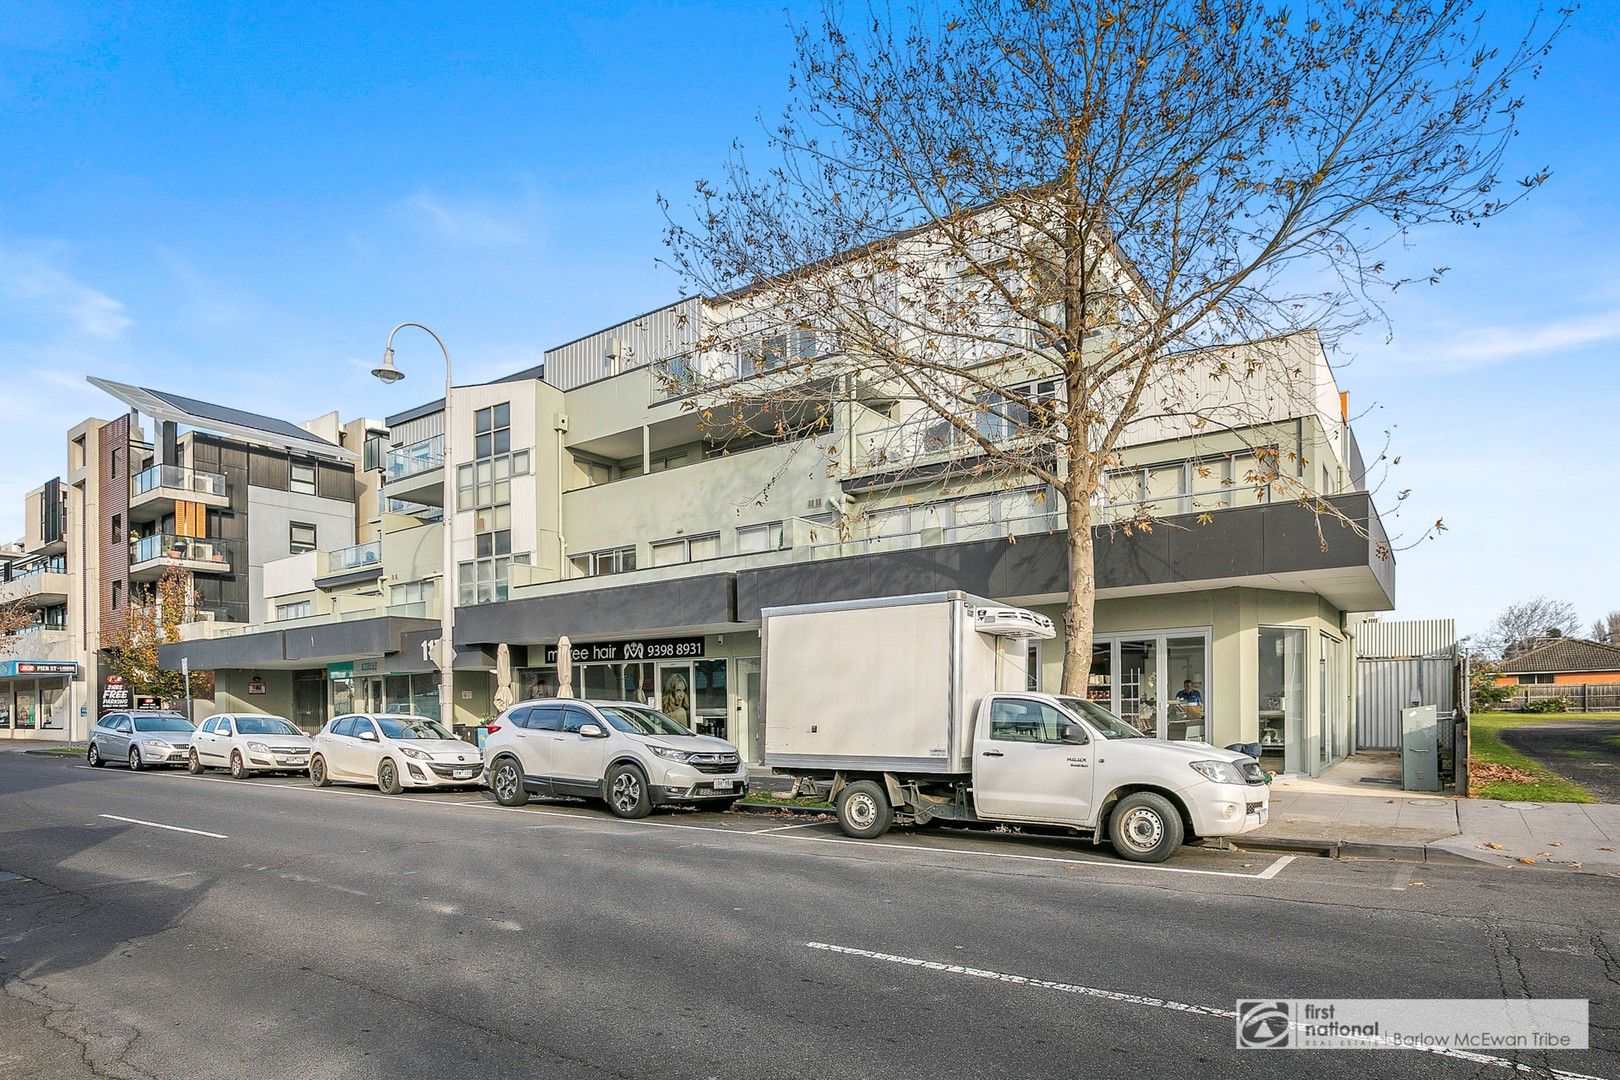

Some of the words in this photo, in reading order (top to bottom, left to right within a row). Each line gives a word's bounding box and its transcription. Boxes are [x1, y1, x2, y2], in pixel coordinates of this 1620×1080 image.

[421, 639, 440, 660] 11
[548, 648, 589, 661] mee
[593, 645, 616, 659] hair
[647, 644, 673, 657] 9398
[676, 642, 701, 655] 8931
[102, 690, 129, 699] FREE
